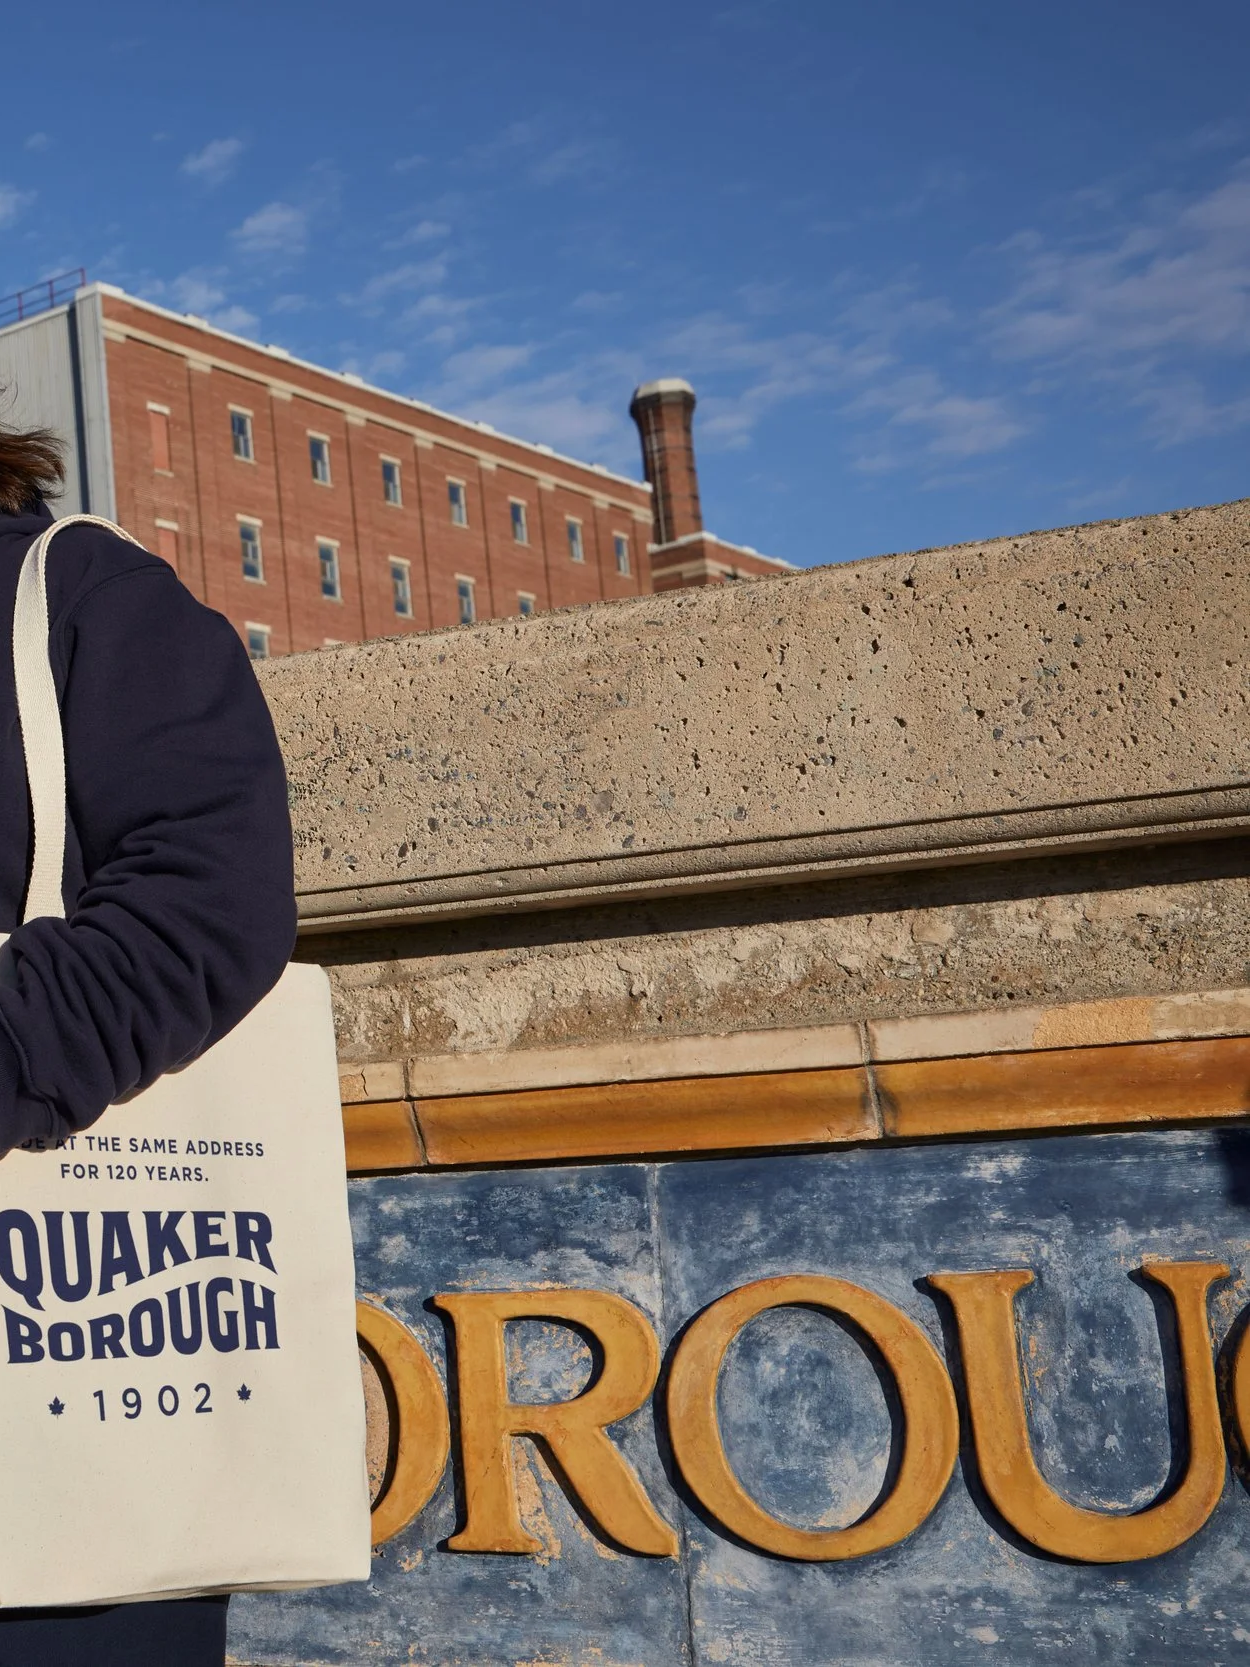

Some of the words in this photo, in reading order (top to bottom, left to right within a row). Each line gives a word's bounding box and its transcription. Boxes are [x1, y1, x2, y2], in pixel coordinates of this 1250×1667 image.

[55, 1136, 77, 1151] AT
[85, 1136, 121, 1152] THE
[129, 1138, 178, 1154] SAME
[186, 1140, 265, 1157] ADDRESS
[60, 1163, 99, 1180] FOR
[106, 1165, 137, 1180] 120
[145, 1166, 209, 1182] YEARS.
[0, 1276, 281, 1364] BOROUGH
[93, 1382, 213, 1421] 1902
